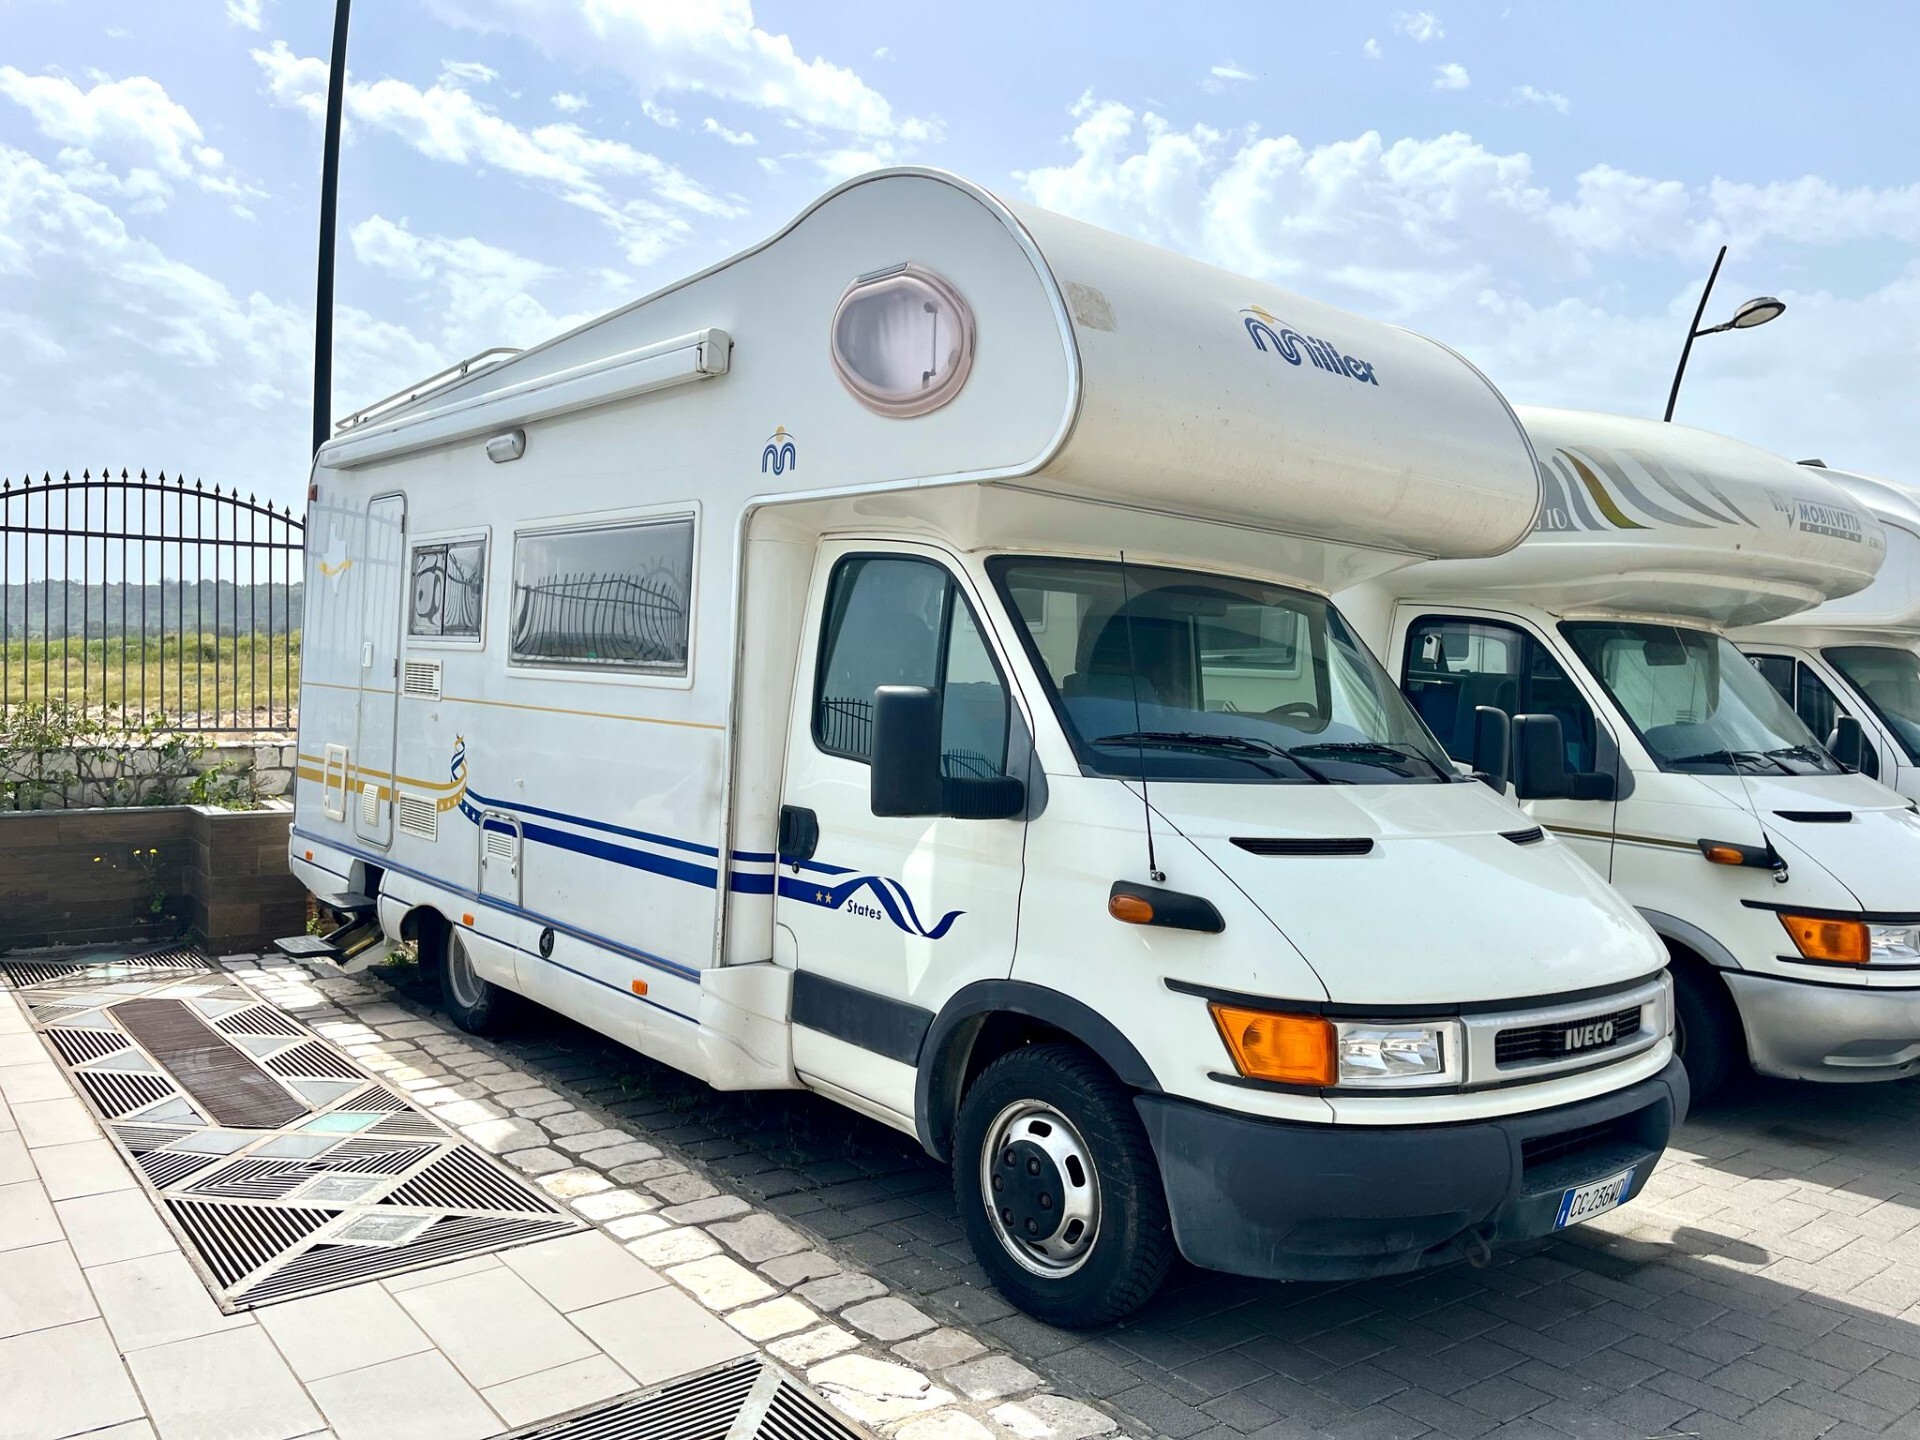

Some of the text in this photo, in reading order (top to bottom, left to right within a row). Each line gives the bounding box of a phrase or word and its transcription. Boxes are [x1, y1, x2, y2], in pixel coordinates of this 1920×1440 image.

[1244, 317, 1379, 386] Miller
[1799, 503, 1862, 533] MOBILVETTA
[1806, 524, 1859, 541] DESIGN
[847, 899, 882, 920] States
[1565, 1021, 1613, 1050] IVECO
